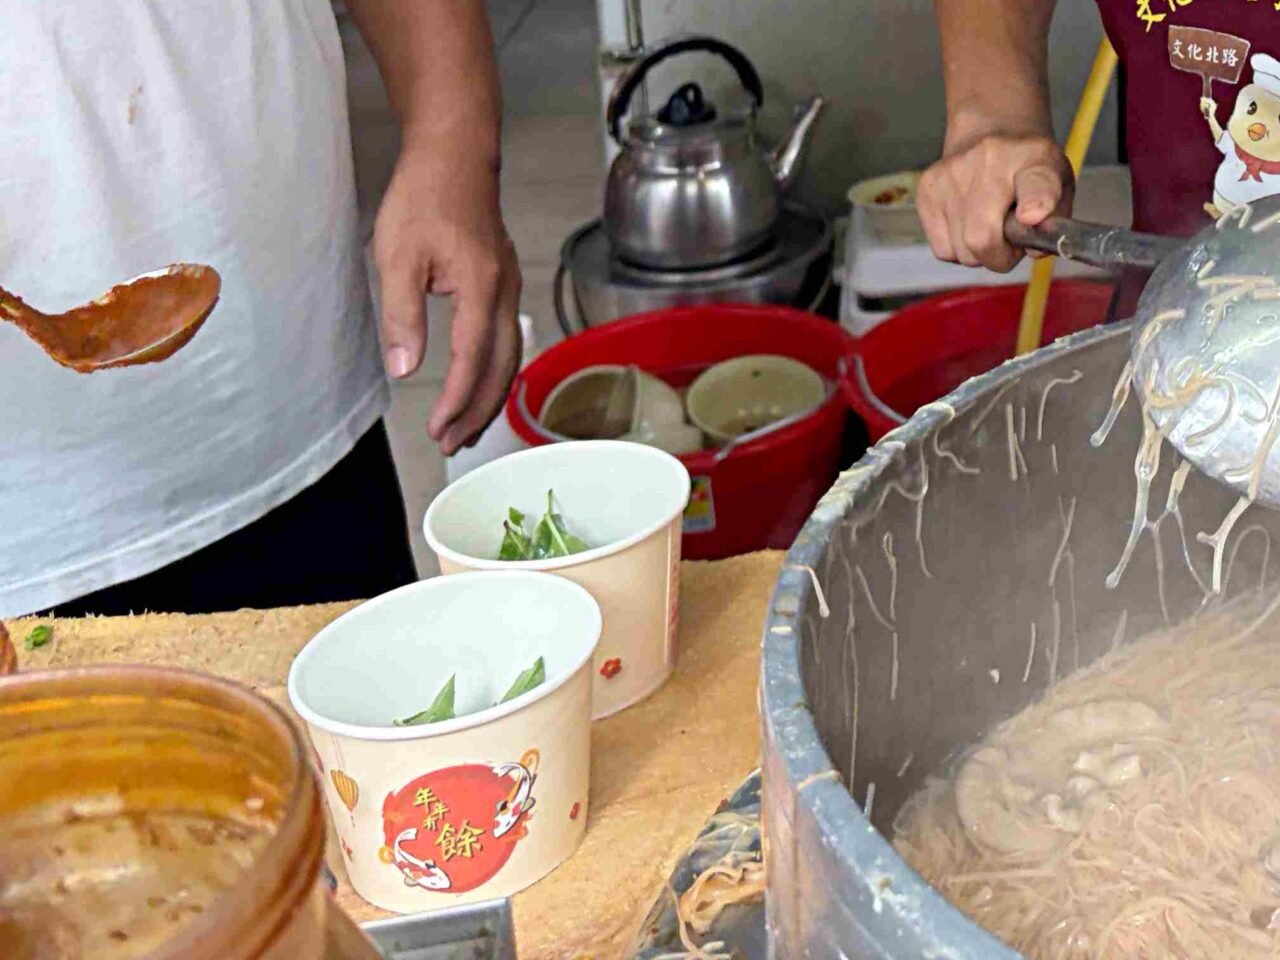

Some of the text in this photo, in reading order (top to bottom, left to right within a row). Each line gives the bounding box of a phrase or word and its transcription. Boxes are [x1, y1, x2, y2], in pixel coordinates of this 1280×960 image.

[1171, 40, 1239, 67] 文化北路
[413, 787, 486, 862] 年年有餘
